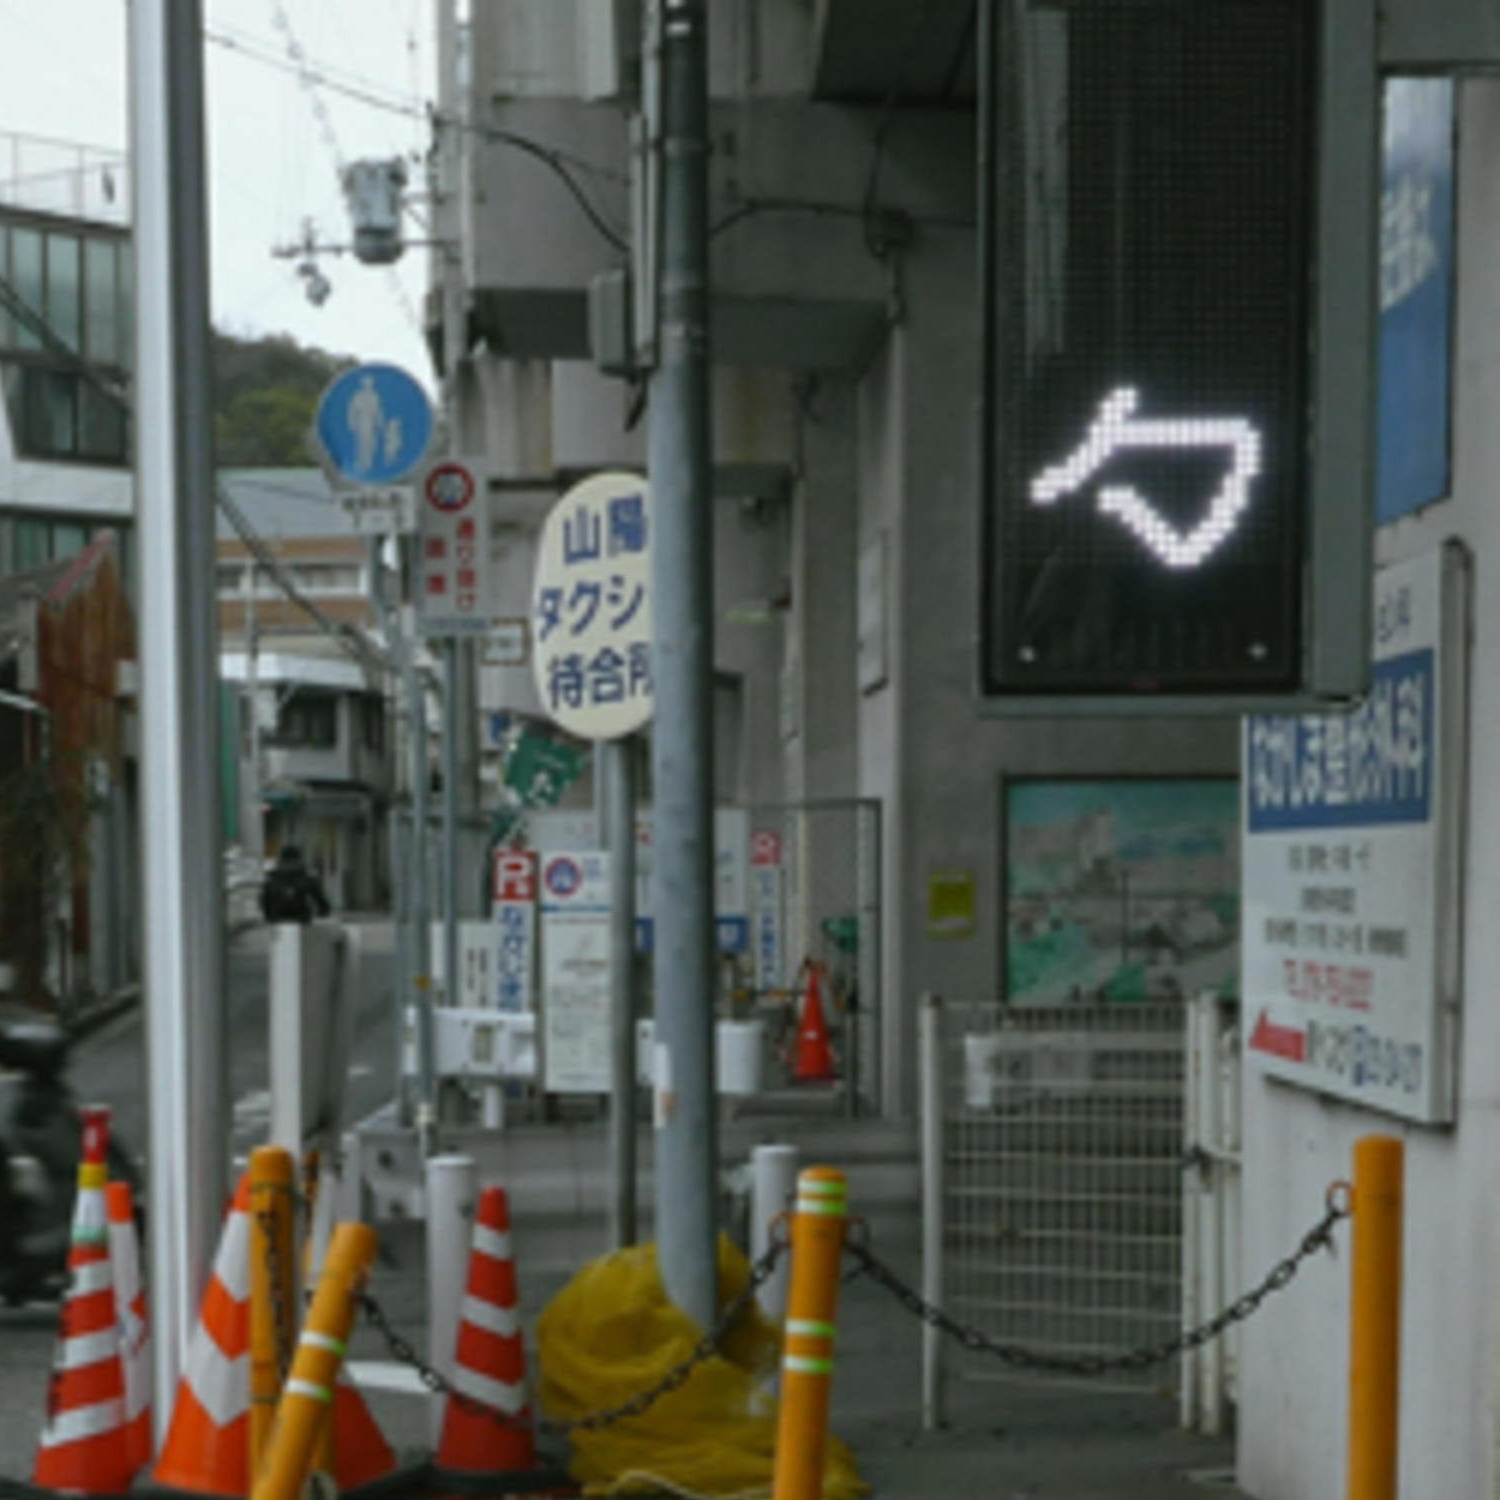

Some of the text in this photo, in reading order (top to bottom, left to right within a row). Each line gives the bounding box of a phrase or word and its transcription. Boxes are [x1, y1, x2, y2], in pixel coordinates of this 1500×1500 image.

[562, 491, 646, 566] 山陽
[536, 574, 644, 643] タクシ
